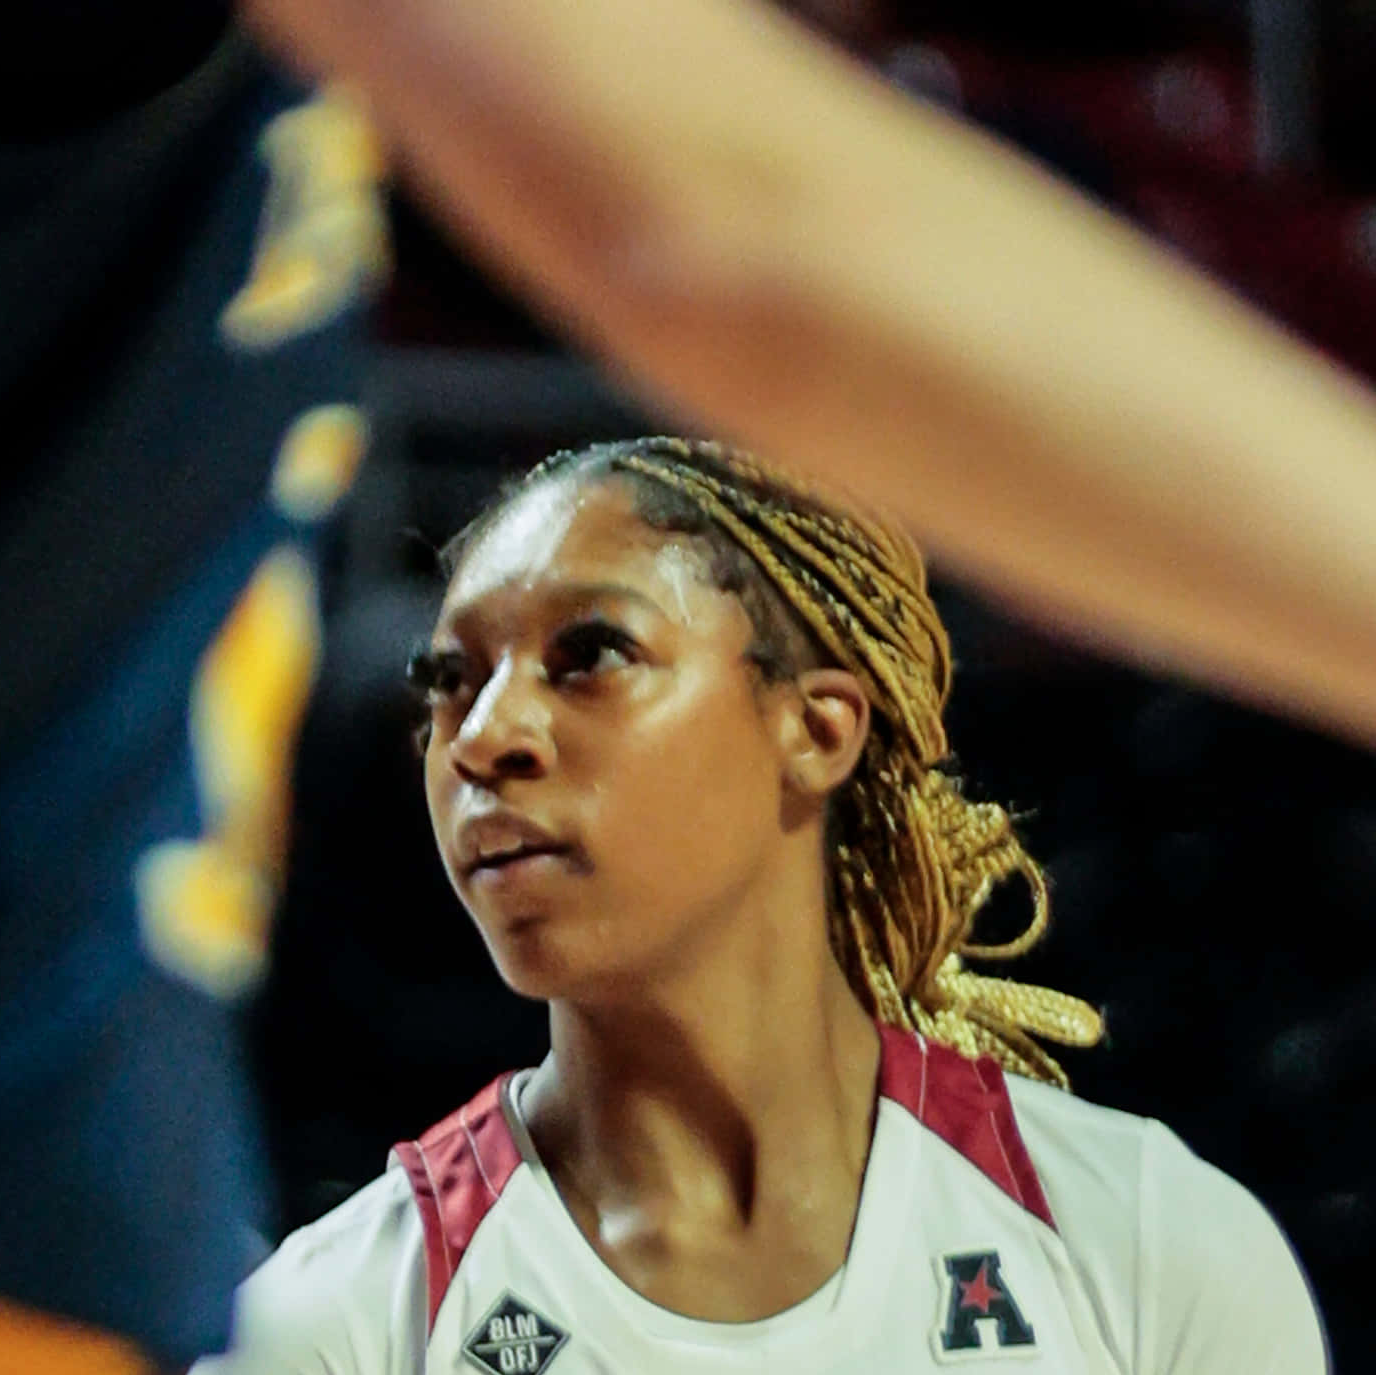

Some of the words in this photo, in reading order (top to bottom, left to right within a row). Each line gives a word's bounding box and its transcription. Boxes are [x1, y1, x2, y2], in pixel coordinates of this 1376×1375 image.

[938, 1248, 1037, 1353] A
[488, 1312, 539, 1342] BLM
[499, 1342, 539, 1375] OFJ
